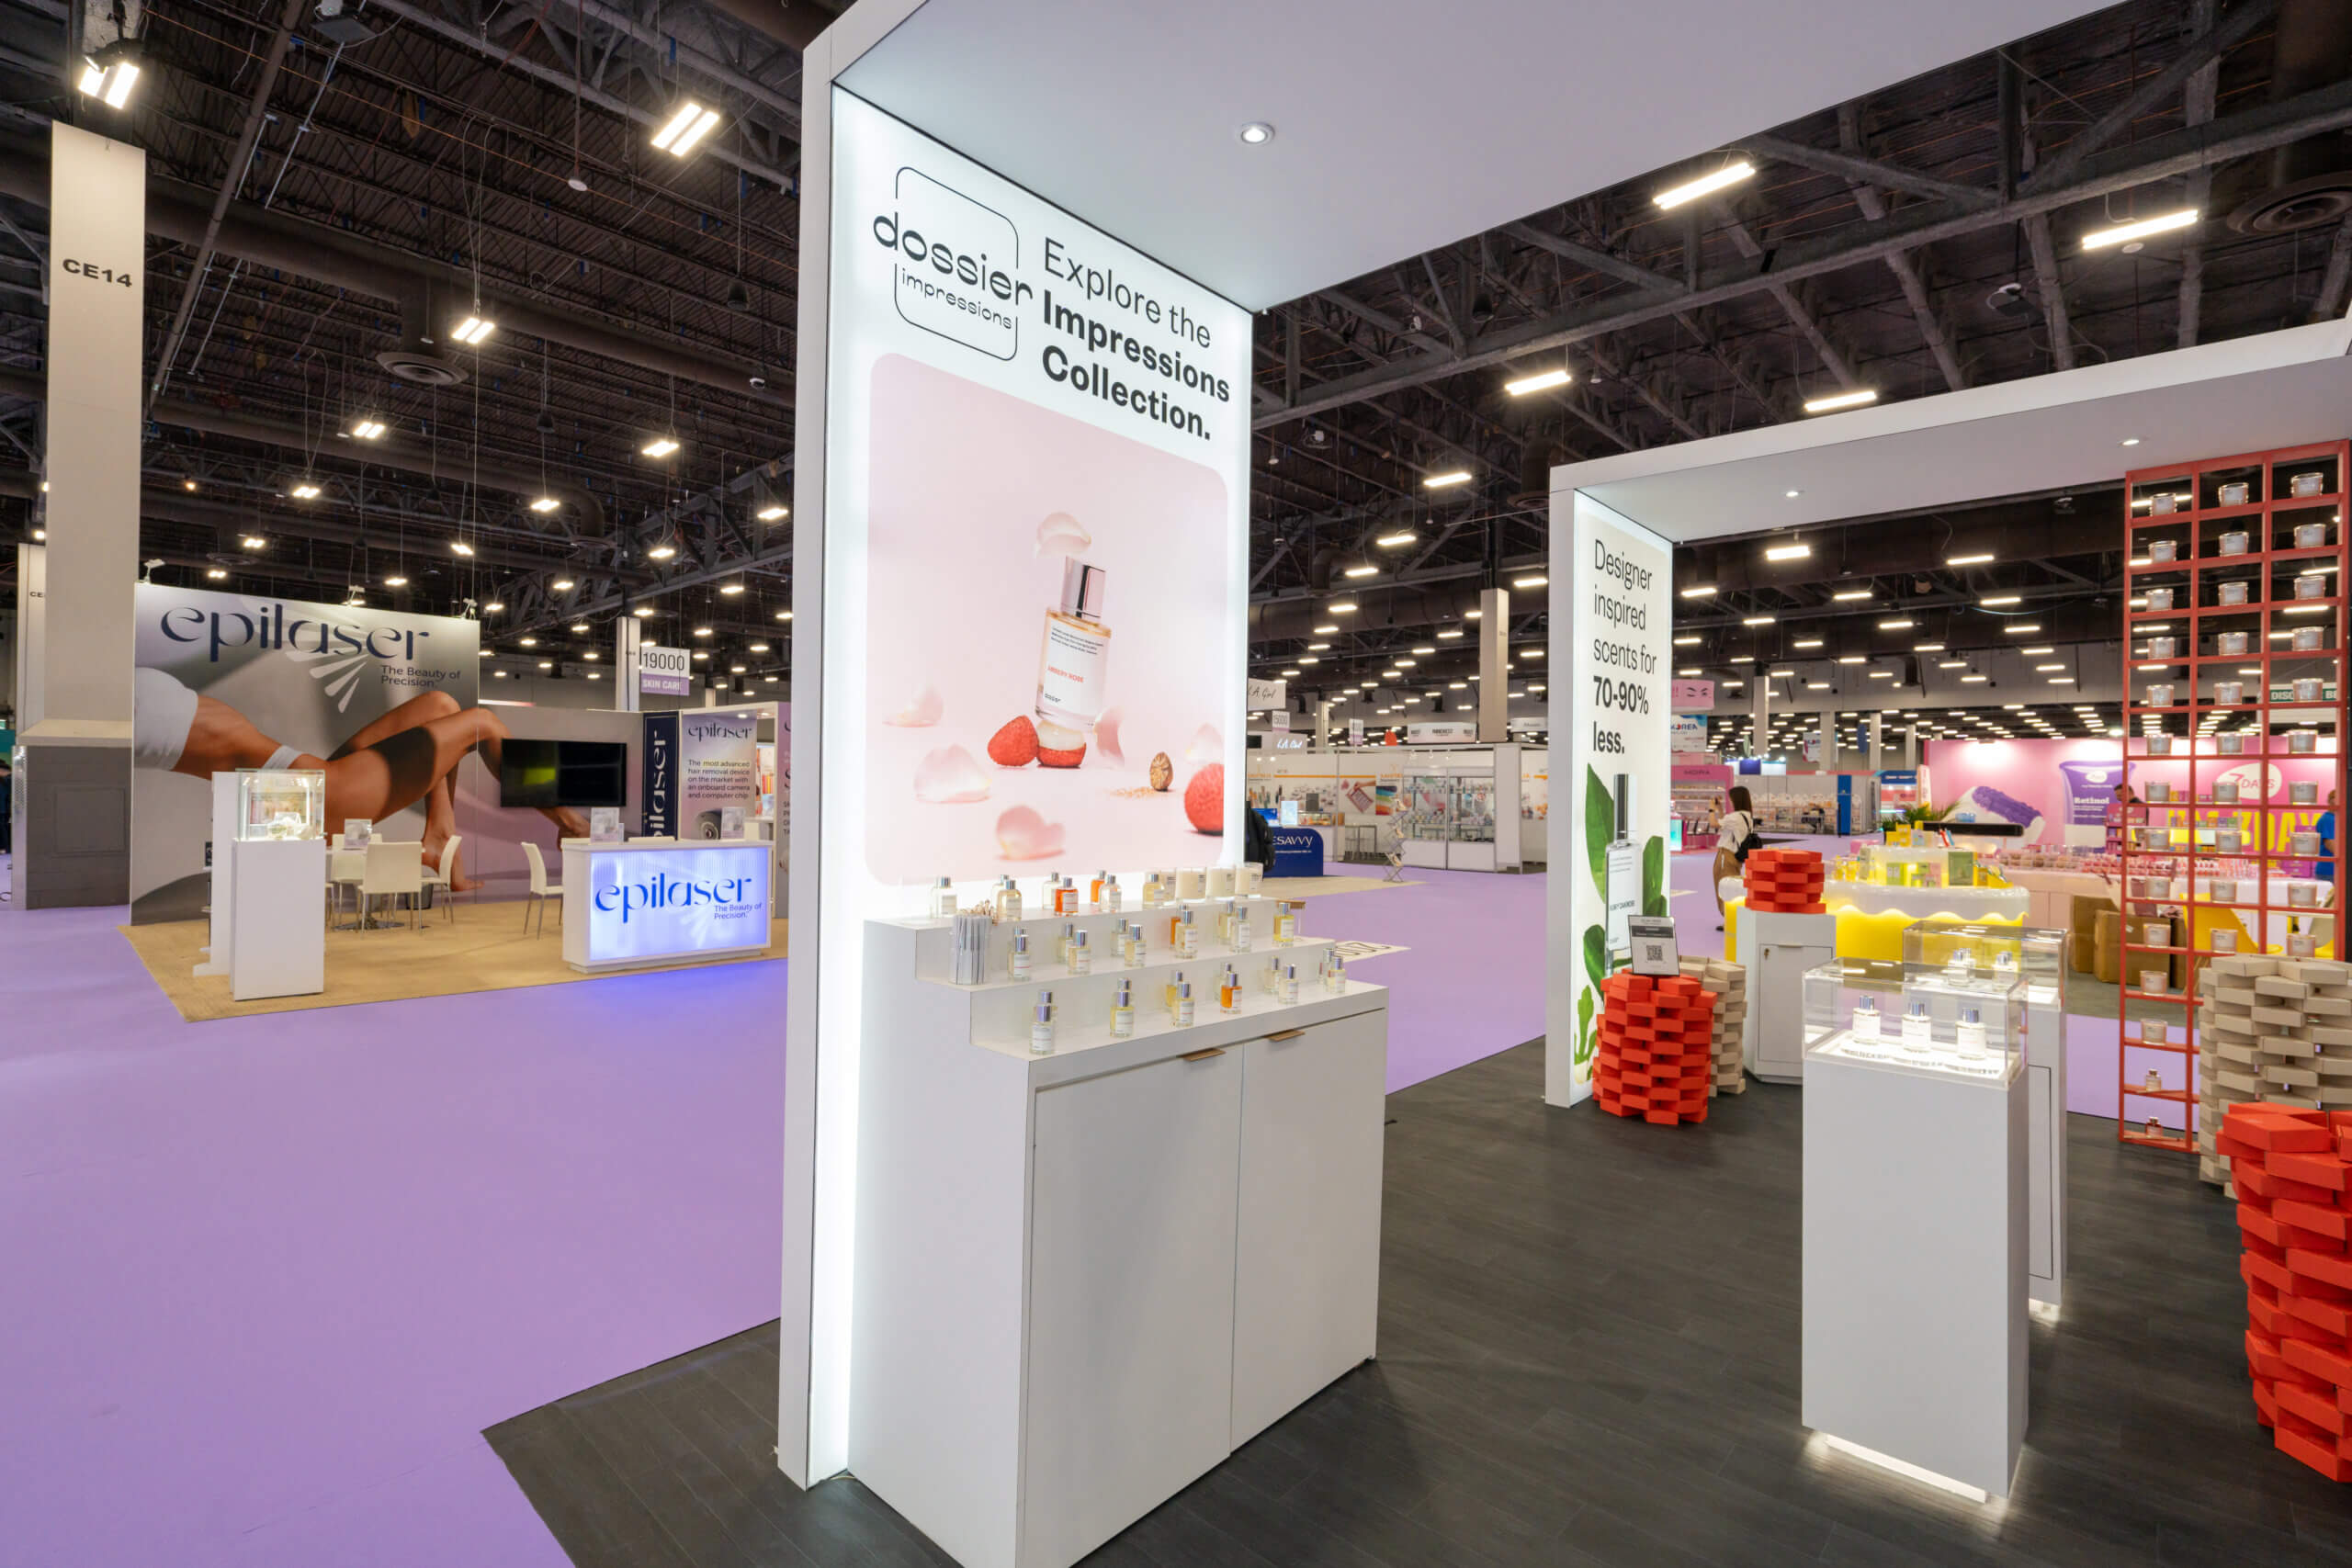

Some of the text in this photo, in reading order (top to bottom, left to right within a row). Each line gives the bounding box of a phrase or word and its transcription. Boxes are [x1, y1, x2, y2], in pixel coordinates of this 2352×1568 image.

[62, 258, 133, 288] CE14
[873, 211, 1034, 306] dossier
[901, 267, 1012, 331] impressions
[1044, 236, 1212, 349] Explore the
[1043, 290, 1230, 402] Impressions
[1042, 345, 1211, 441] Collection.
[1594, 538, 1652, 591] Designer
[1594, 584, 1646, 631] inspired
[160, 604, 430, 662] epilaser
[1593, 638, 1657, 675] scents for
[381, 665, 461, 682] The Beauty of
[643, 651, 685, 671] 19000
[643, 678, 683, 691] SKIN CARE
[1593, 676, 1649, 715] 70-90%
[688, 723, 752, 742] epilaser
[1593, 721, 1624, 754] less.
[649, 730, 666, 837] ilaser
[594, 873, 752, 924] epilaser
[729, 903, 752, 912] Beauty
